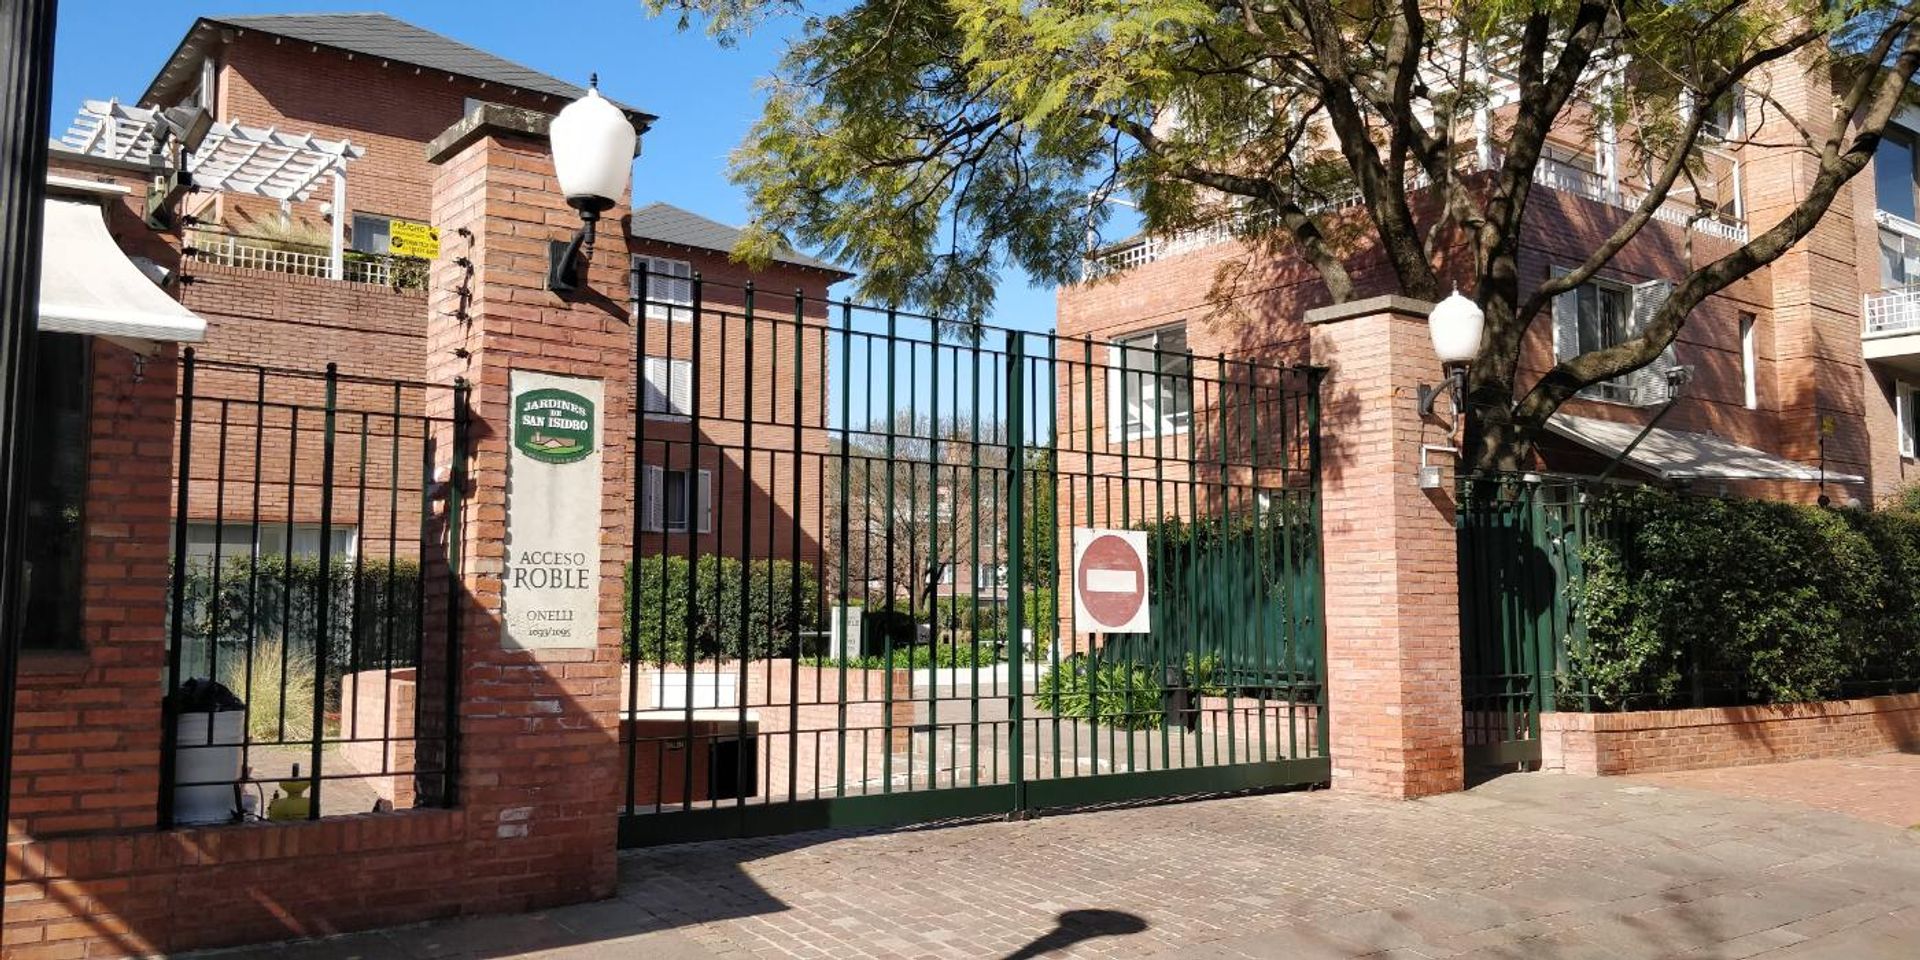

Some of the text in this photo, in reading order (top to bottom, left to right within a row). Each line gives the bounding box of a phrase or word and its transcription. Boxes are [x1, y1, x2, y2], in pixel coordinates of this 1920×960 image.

[523, 399, 586, 416] JARDINES
[522, 415, 588, 430] SAN ISIDRO
[519, 551, 586, 566] ACCESO
[513, 567, 590, 591] ROBLE
[526, 610, 574, 621] ONELLI
